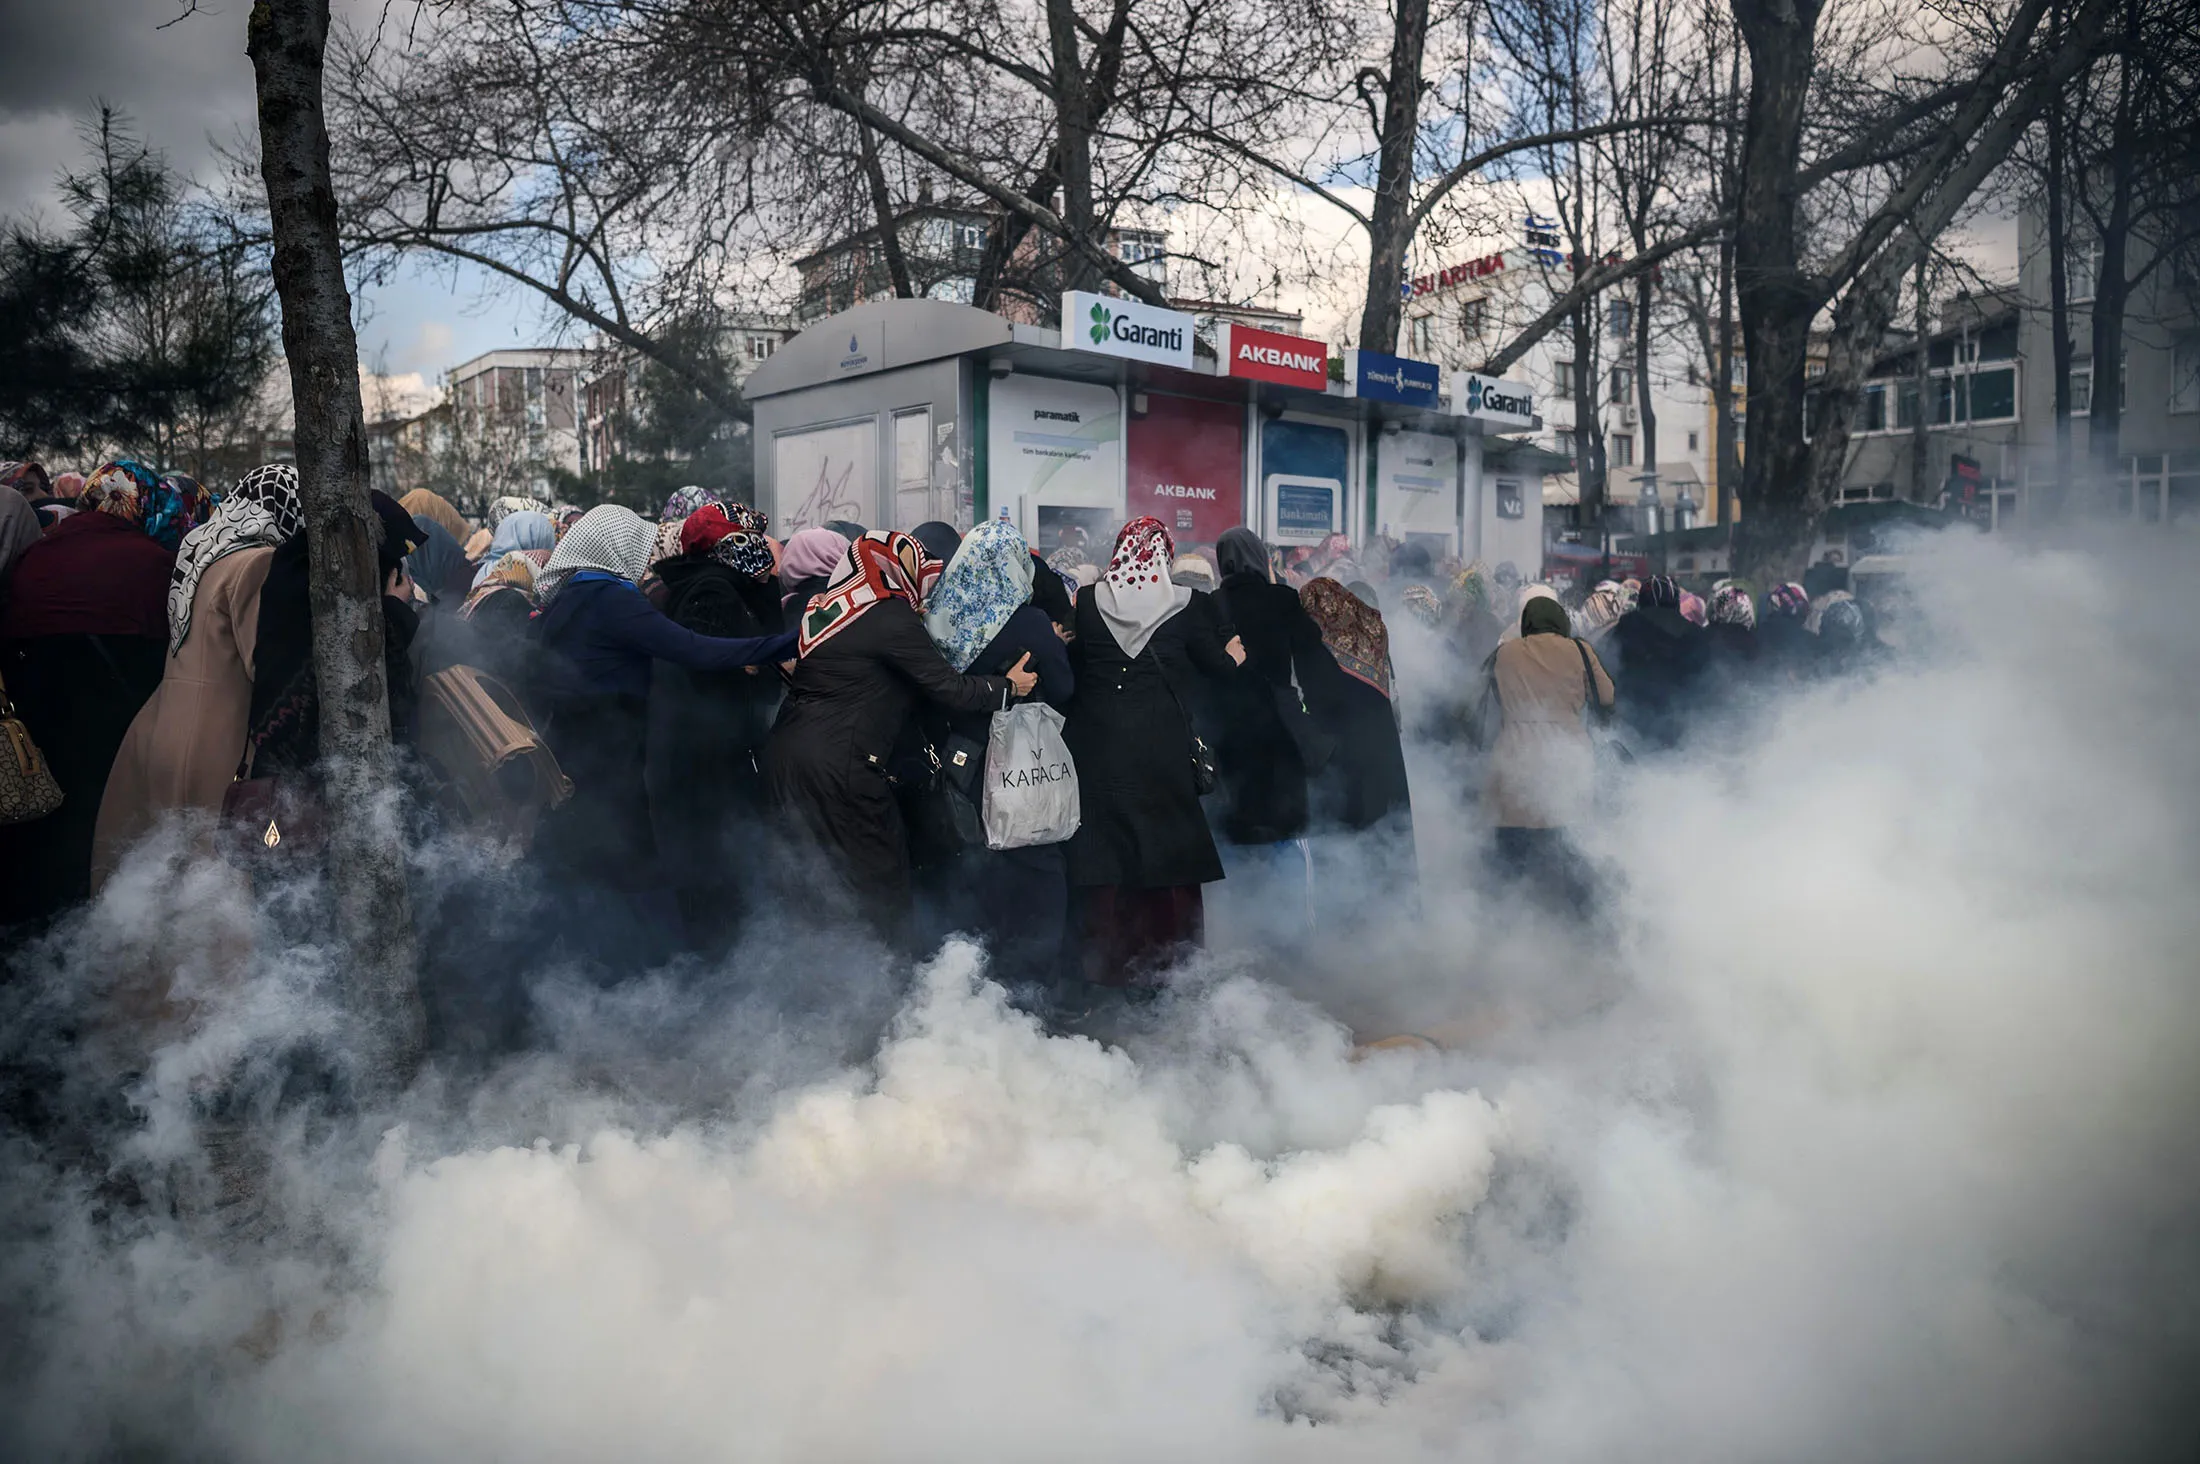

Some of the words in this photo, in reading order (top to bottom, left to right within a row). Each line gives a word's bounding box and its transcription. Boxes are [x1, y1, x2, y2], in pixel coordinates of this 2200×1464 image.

[1413, 272, 1435, 296] SU
[1113, 314, 1183, 352] Garanti
[1238, 343, 1321, 374] AKBANK
[1482, 385, 1533, 418] Garanti
[1034, 409, 1081, 424] paramatik
[1154, 483, 1217, 501] AKBANK
[1280, 507, 1330, 521] Bankamatik
[1001, 761, 1072, 789] KARACA
